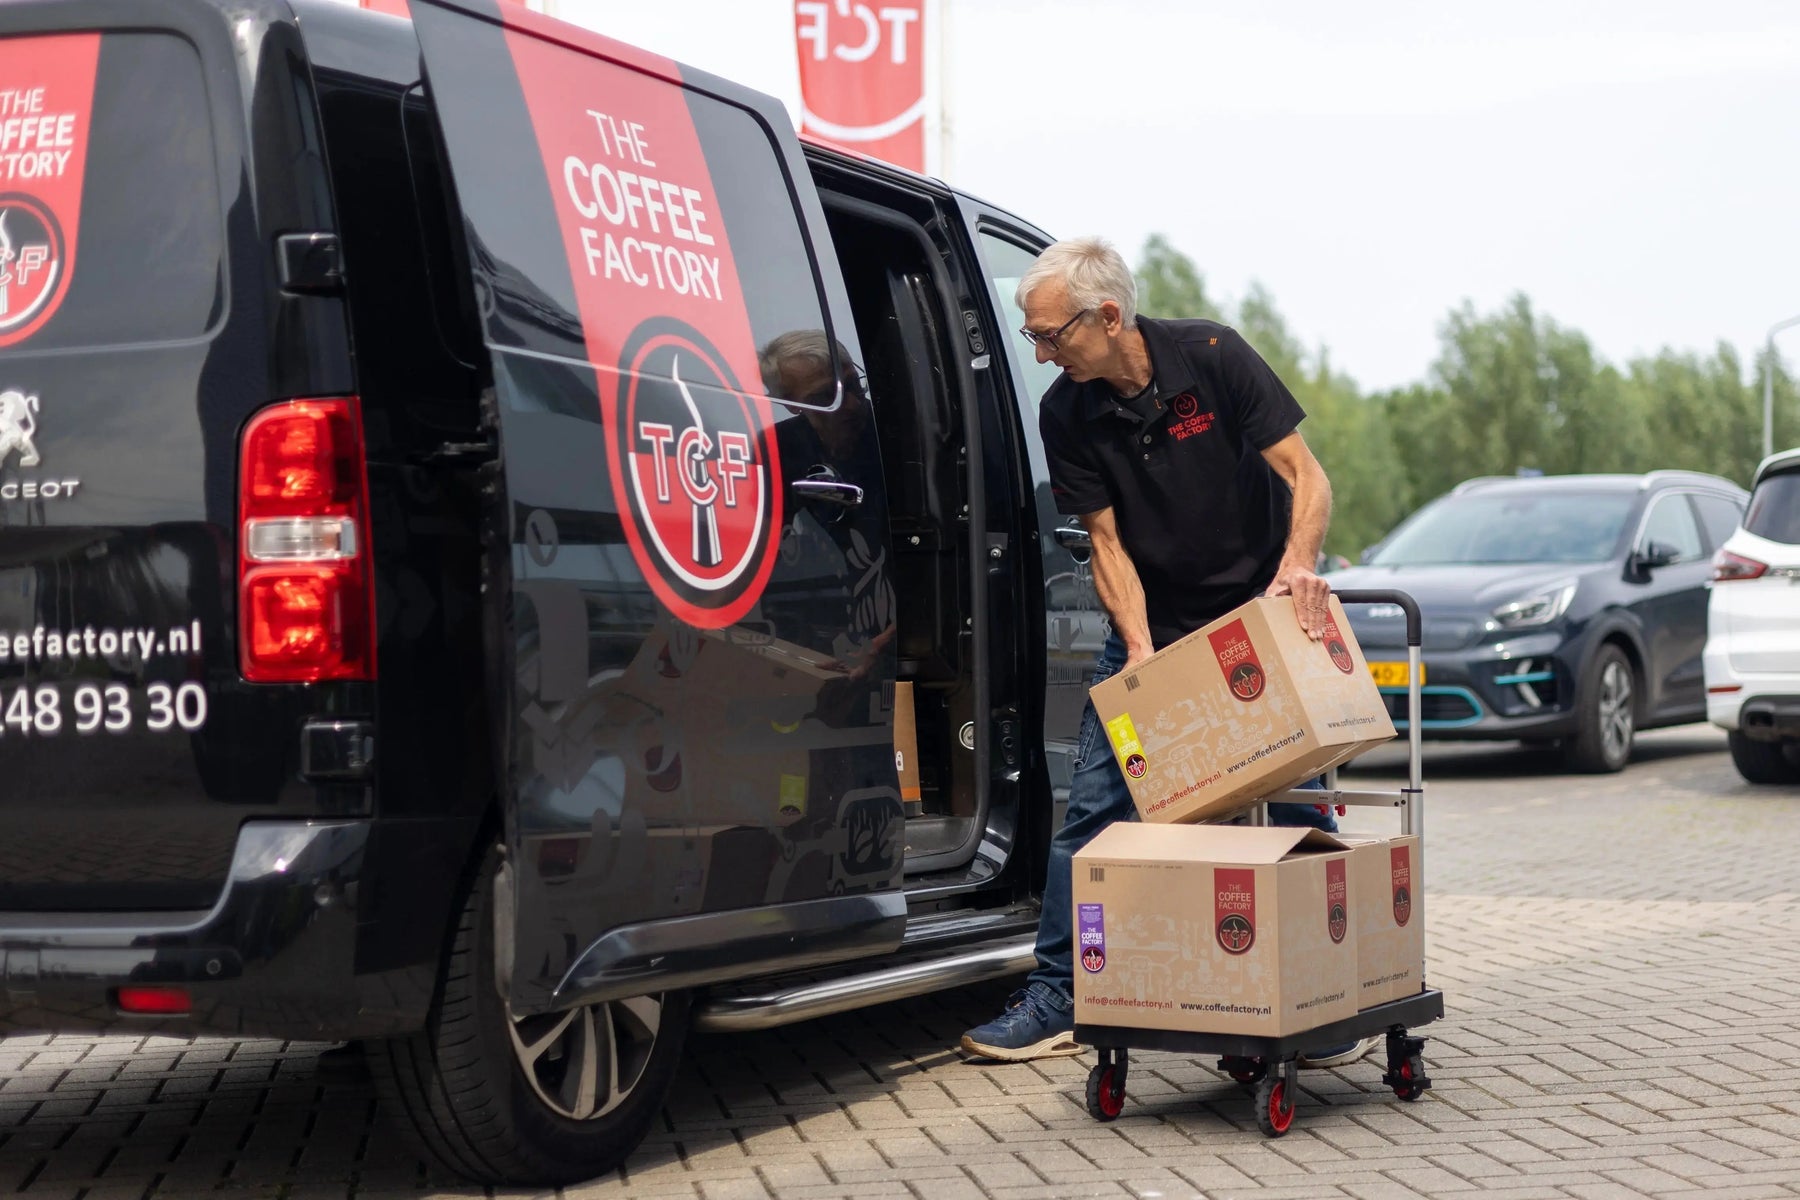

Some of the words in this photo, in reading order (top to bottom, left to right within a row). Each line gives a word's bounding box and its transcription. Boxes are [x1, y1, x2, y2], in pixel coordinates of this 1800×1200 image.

[0, 88, 45, 115] THE
[0, 114, 76, 149] FFEE
[586, 109, 656, 167] THE
[0, 151, 71, 179] TORY
[564, 155, 715, 246] COFFEE
[580, 227, 723, 301] FACTORY
[1168, 423, 1184, 435] THE
[638, 421, 751, 507] TCF
[1219, 640, 1249, 660] COFFEE
[1224, 637, 1239, 648] THE
[1222, 648, 1252, 668] FACTORY
[0, 686, 61, 733] 48
[74, 686, 131, 730] 93
[147, 684, 207, 729] 30
[1145, 771, 1222, 815] info@coffeefactory.nl
[1226, 729, 1306, 774] www.coffeefactory.nl
[1218, 892, 1251, 902] COFFEE
[1218, 902, 1252, 910] FACTORY
[1081, 932, 1103, 940] COFFEE
[1084, 995, 1173, 1010] info@coffeefactory.nl
[1180, 1001, 1272, 1015] www.coffeefactory.nl
